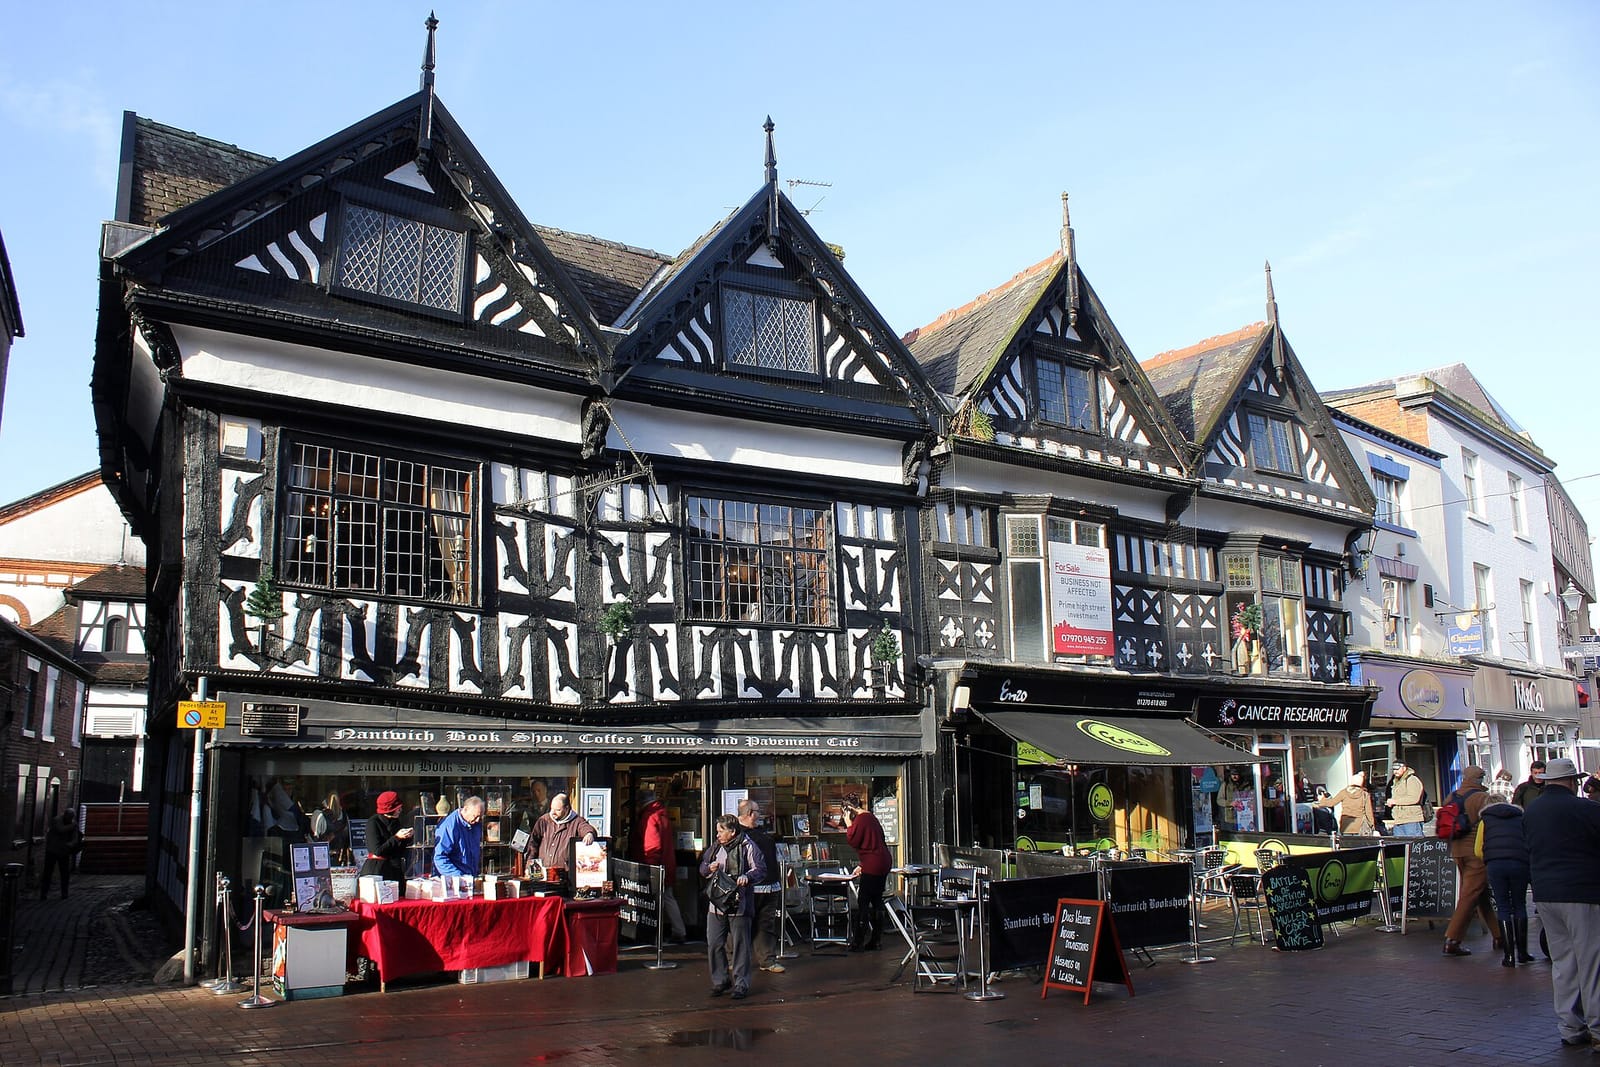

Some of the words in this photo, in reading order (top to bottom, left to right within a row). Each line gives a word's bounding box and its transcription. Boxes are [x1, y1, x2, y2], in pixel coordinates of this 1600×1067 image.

[1055, 562, 1065, 571] For
[1066, 564, 1080, 573] Sale
[1061, 577, 1090, 587] BUSINESS
[1091, 580, 1101, 588] NOT
[1067, 588, 1096, 597] AFFECTED
[1059, 601, 1075, 609] Prime
[1076, 602, 1088, 612] high
[1089, 603, 1106, 612] street
[1067, 611, 1099, 620] investment
[1061, 634, 1082, 643] 07970
[1000, 679, 1028, 702] Enzo
[1237, 705, 1281, 721] CANCER
[1284, 707, 1334, 722] RESEARCH
[1335, 709, 1349, 723] UK
[330, 728, 434, 743] Nantwich
[447, 731, 501, 743] Book
[579, 733, 635, 745] Coffee
[641, 734, 703, 746] Lounge
[710, 735, 738, 745] and
[745, 736, 820, 747] Pavement
[826, 737, 860, 747] Café
[419, 760, 452, 772] Book
[457, 761, 492, 774] Shop
[1094, 794, 1110, 808] Enzo
[1270, 876, 1300, 889] BATTLE
[1112, 902, 1147, 914] Nantwich
[1150, 897, 1188, 910] Bookshop
[1004, 914, 1040, 930] Nantwich
[1276, 911, 1308, 929] MULLED
[1051, 968, 1056, 979] A
